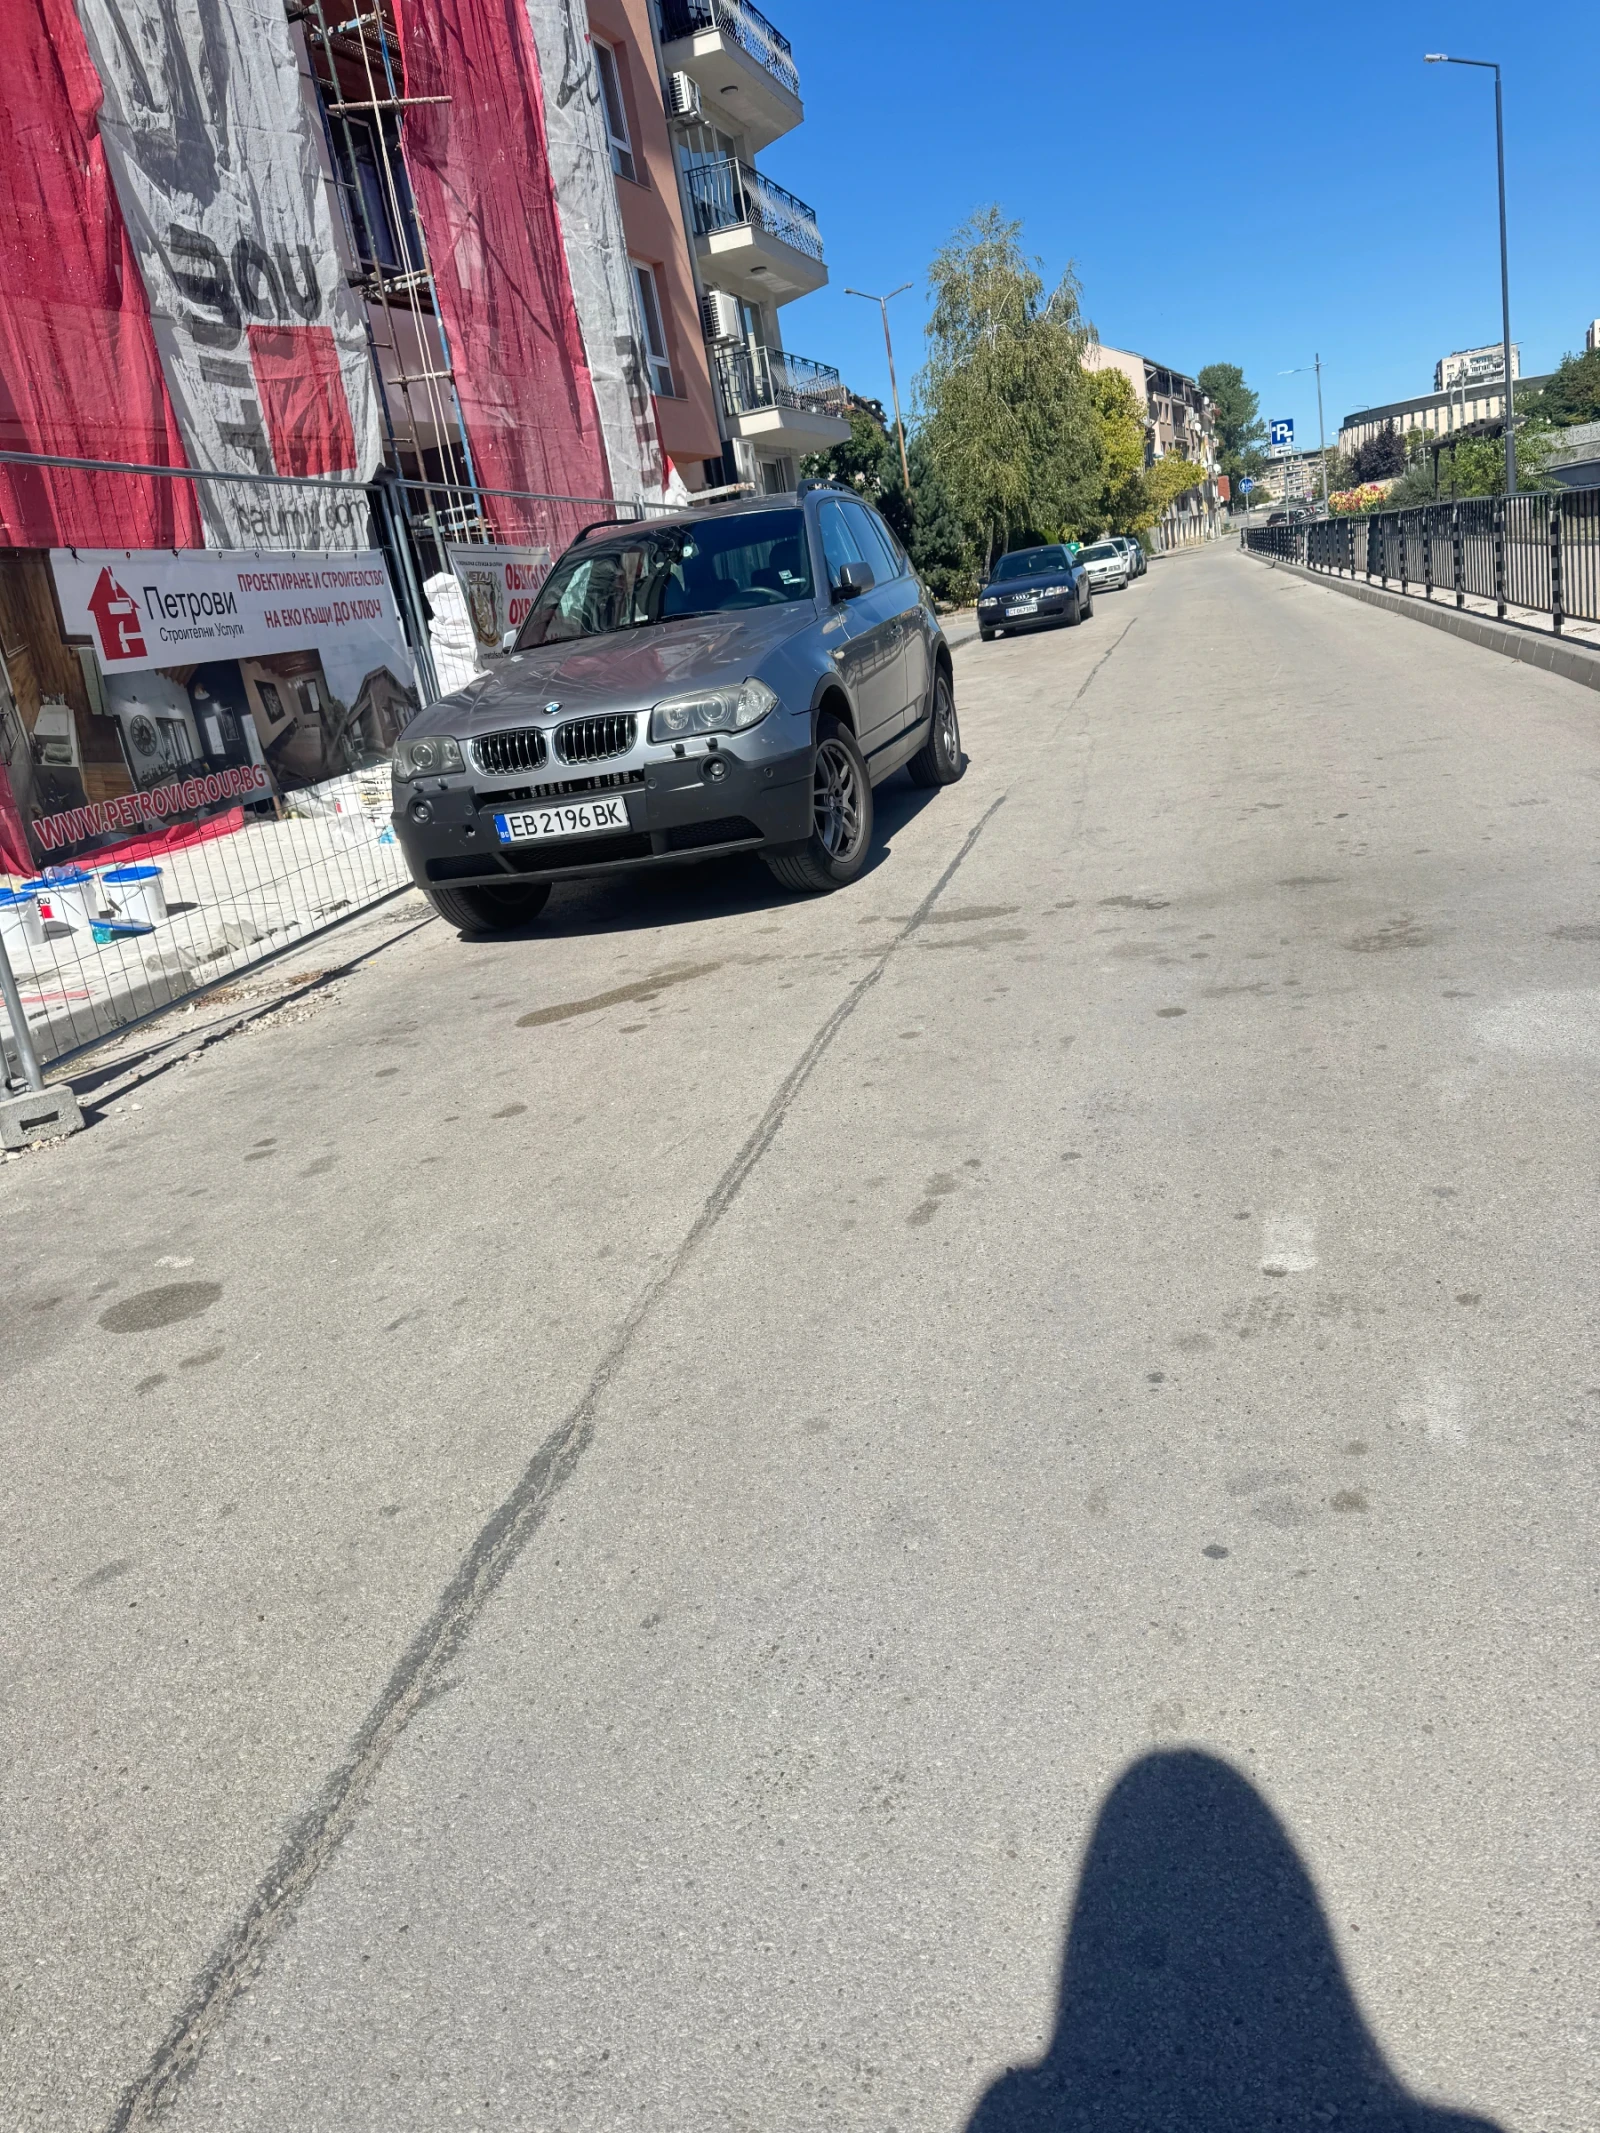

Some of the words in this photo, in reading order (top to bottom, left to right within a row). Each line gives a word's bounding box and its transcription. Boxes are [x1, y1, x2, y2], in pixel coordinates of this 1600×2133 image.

[1276, 423, 1289, 441] P
[237, 571, 313, 593] ПРОЕКТИРАНЕ
[311, 571, 322, 589] И
[321, 569, 385, 589] СТРОИТЕЛСТВО
[143, 586, 238, 625] Петрови
[264, 610, 282, 629] НА
[281, 608, 302, 627] ЕКО
[302, 606, 334, 627] КЪЩИ
[333, 601, 351, 627] ДО
[350, 598, 383, 621] КЛЮЧ
[160, 627, 215, 645] Строителни
[214, 623, 245, 639] Услуги
[32, 763, 267, 850] WWW.PETROVIGROUP.BG
[509, 814, 538, 837] EB
[540, 807, 591, 834] 2196
[593, 802, 623, 827] BK
